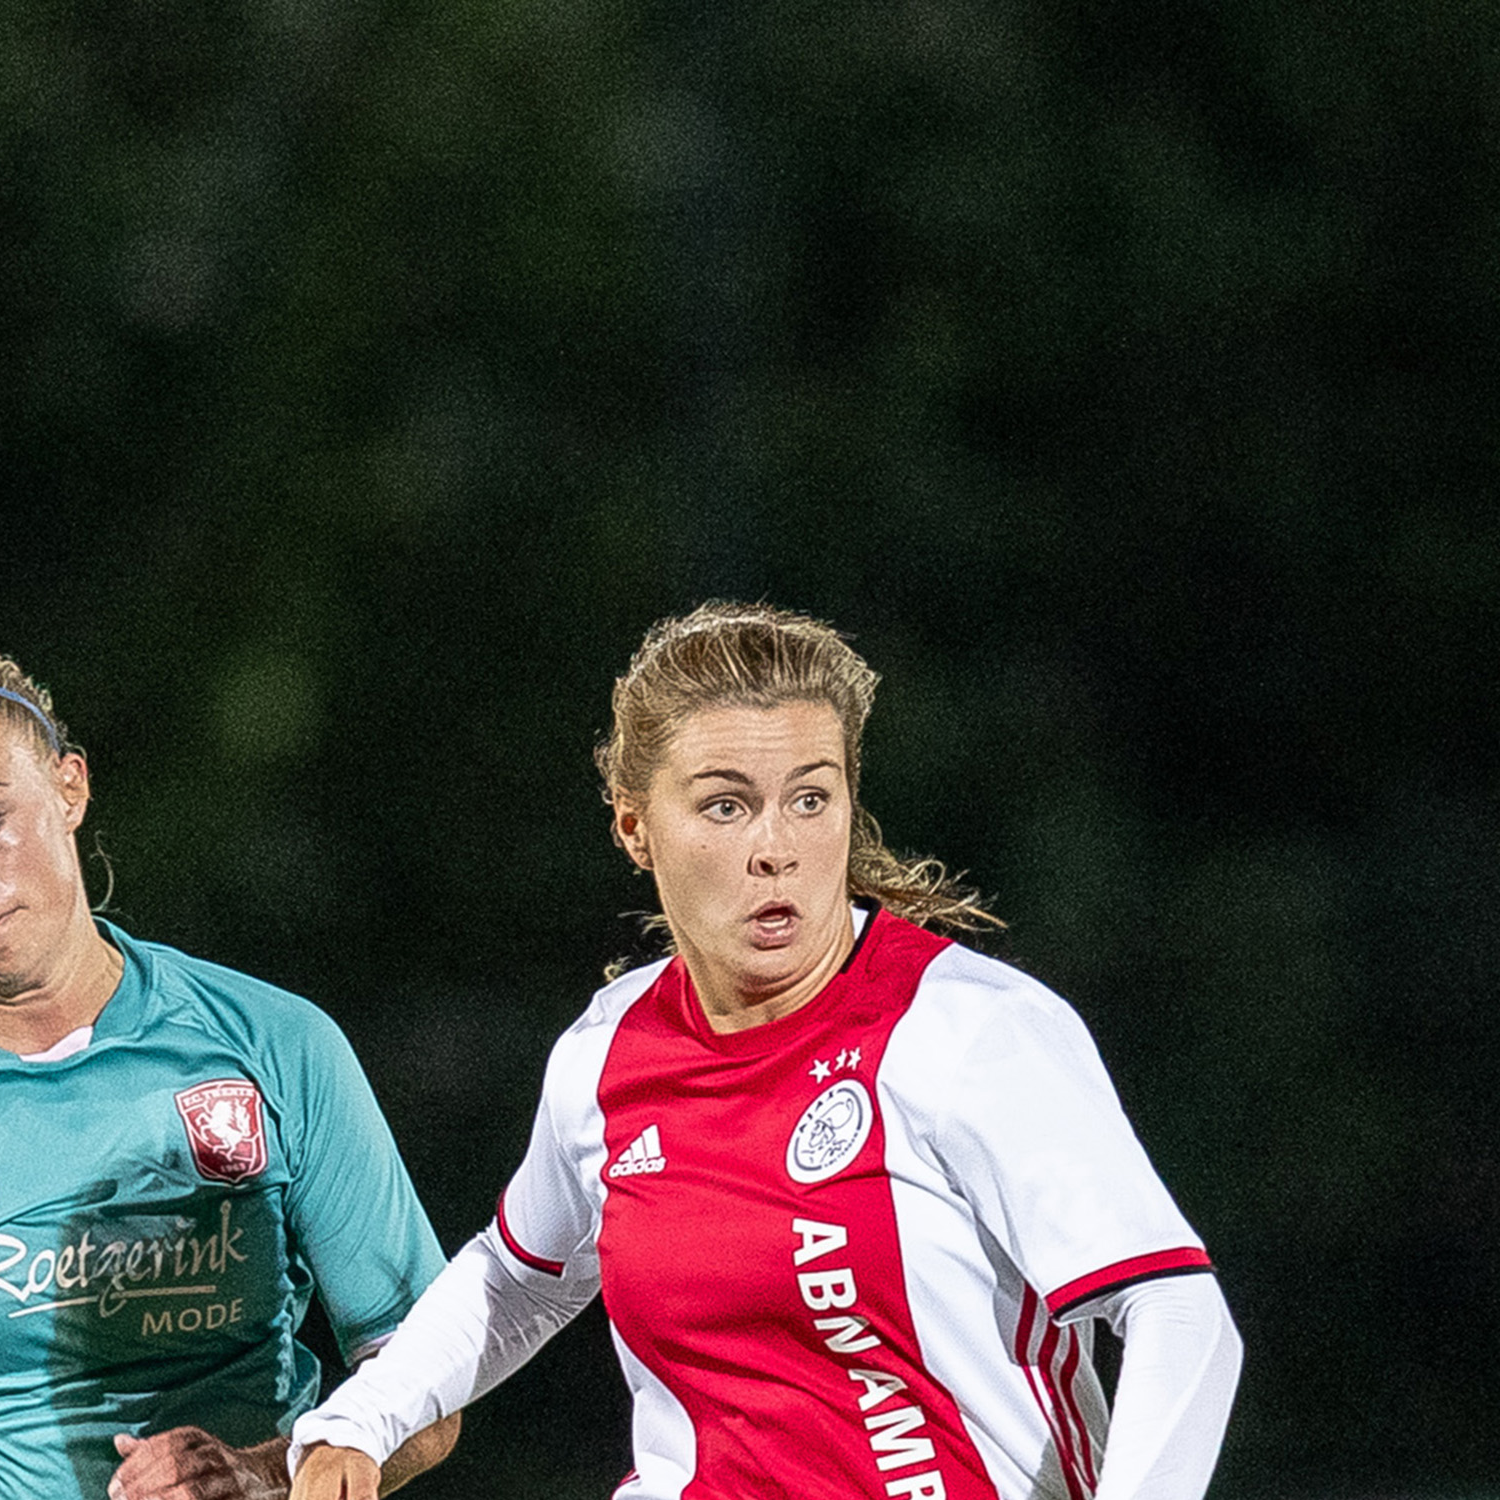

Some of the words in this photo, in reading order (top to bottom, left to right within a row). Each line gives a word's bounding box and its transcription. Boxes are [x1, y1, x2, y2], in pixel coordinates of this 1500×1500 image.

[608, 1156, 668, 1179] adidas
[792, 1217, 882, 1355] ABN
[140, 1298, 244, 1336] MODE
